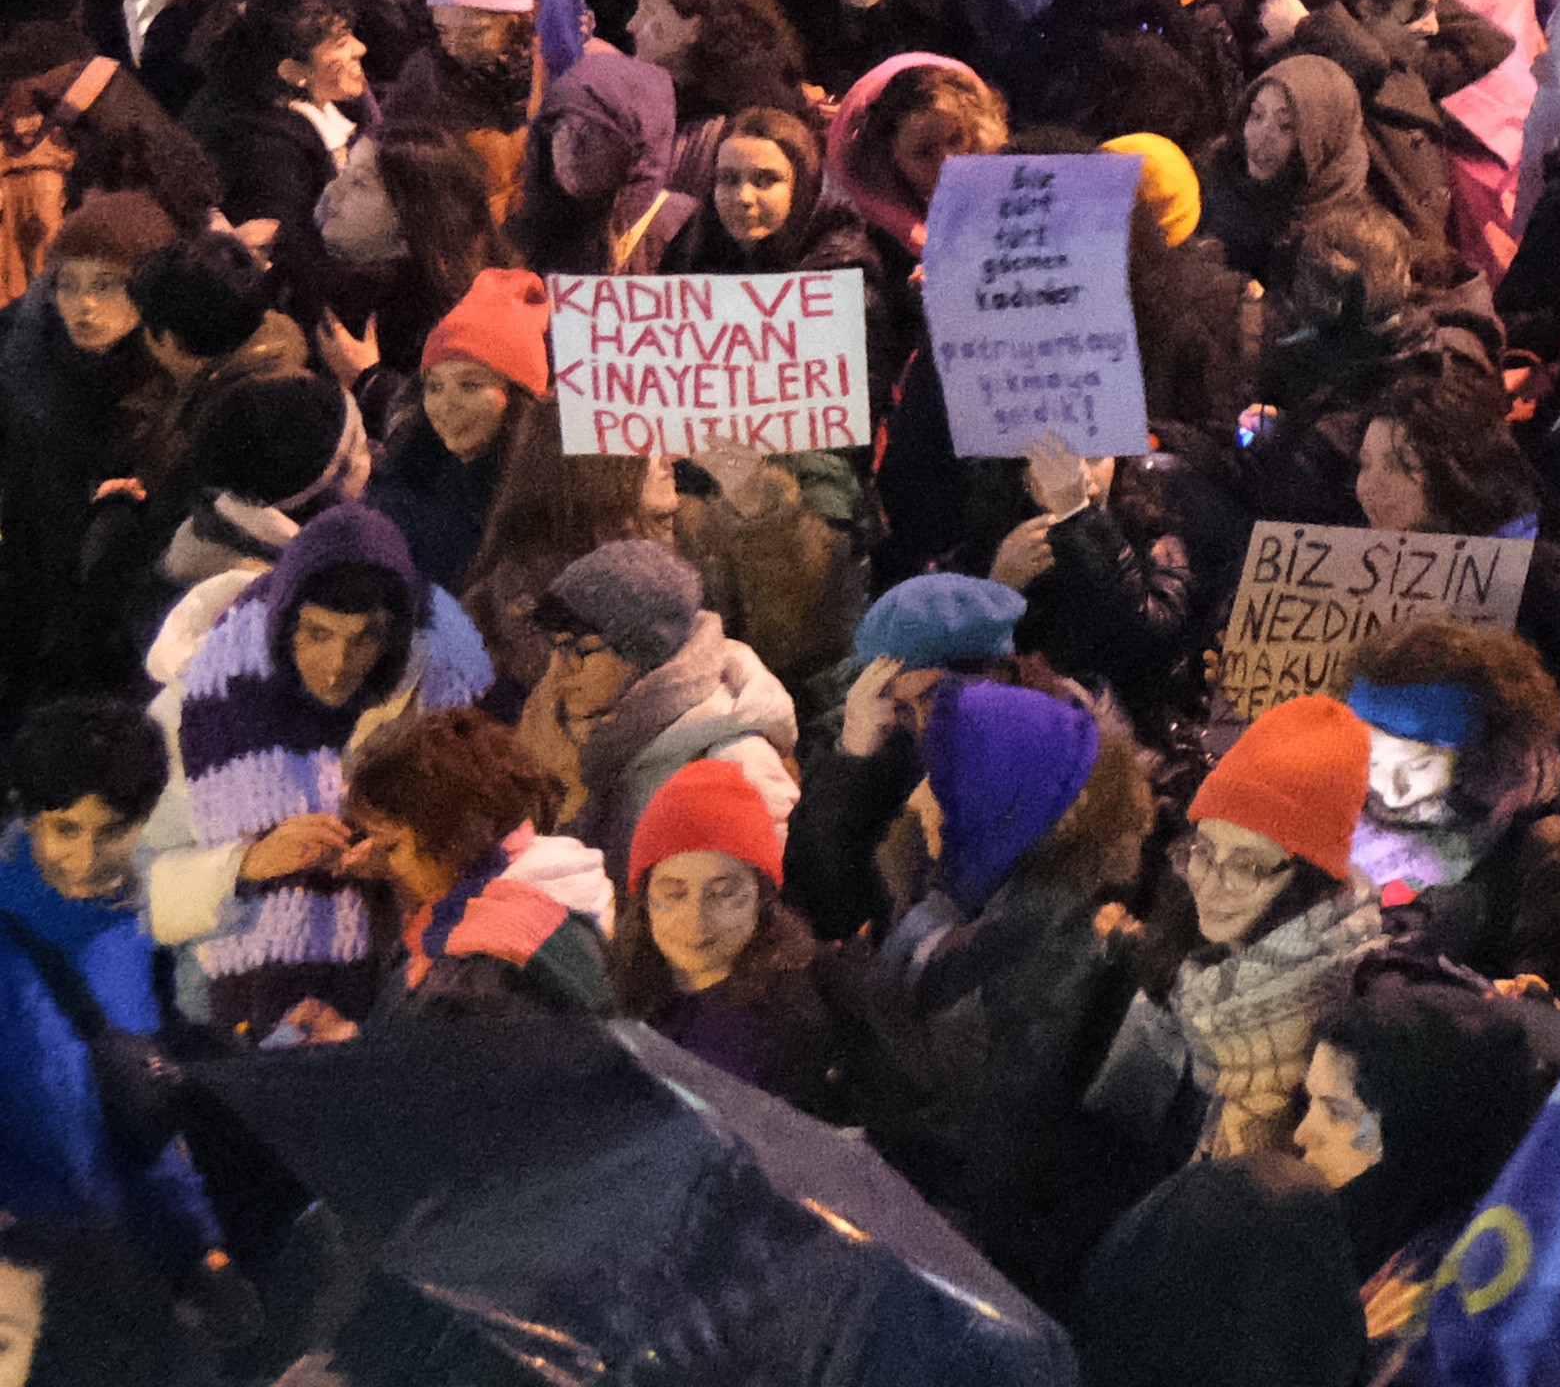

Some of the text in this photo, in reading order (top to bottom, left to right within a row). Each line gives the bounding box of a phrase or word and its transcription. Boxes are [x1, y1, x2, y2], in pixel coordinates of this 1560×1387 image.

[551, 274, 834, 323] KADIN VE
[590, 319, 797, 364] HAYVAN
[1253, 527, 1335, 589] BİZ
